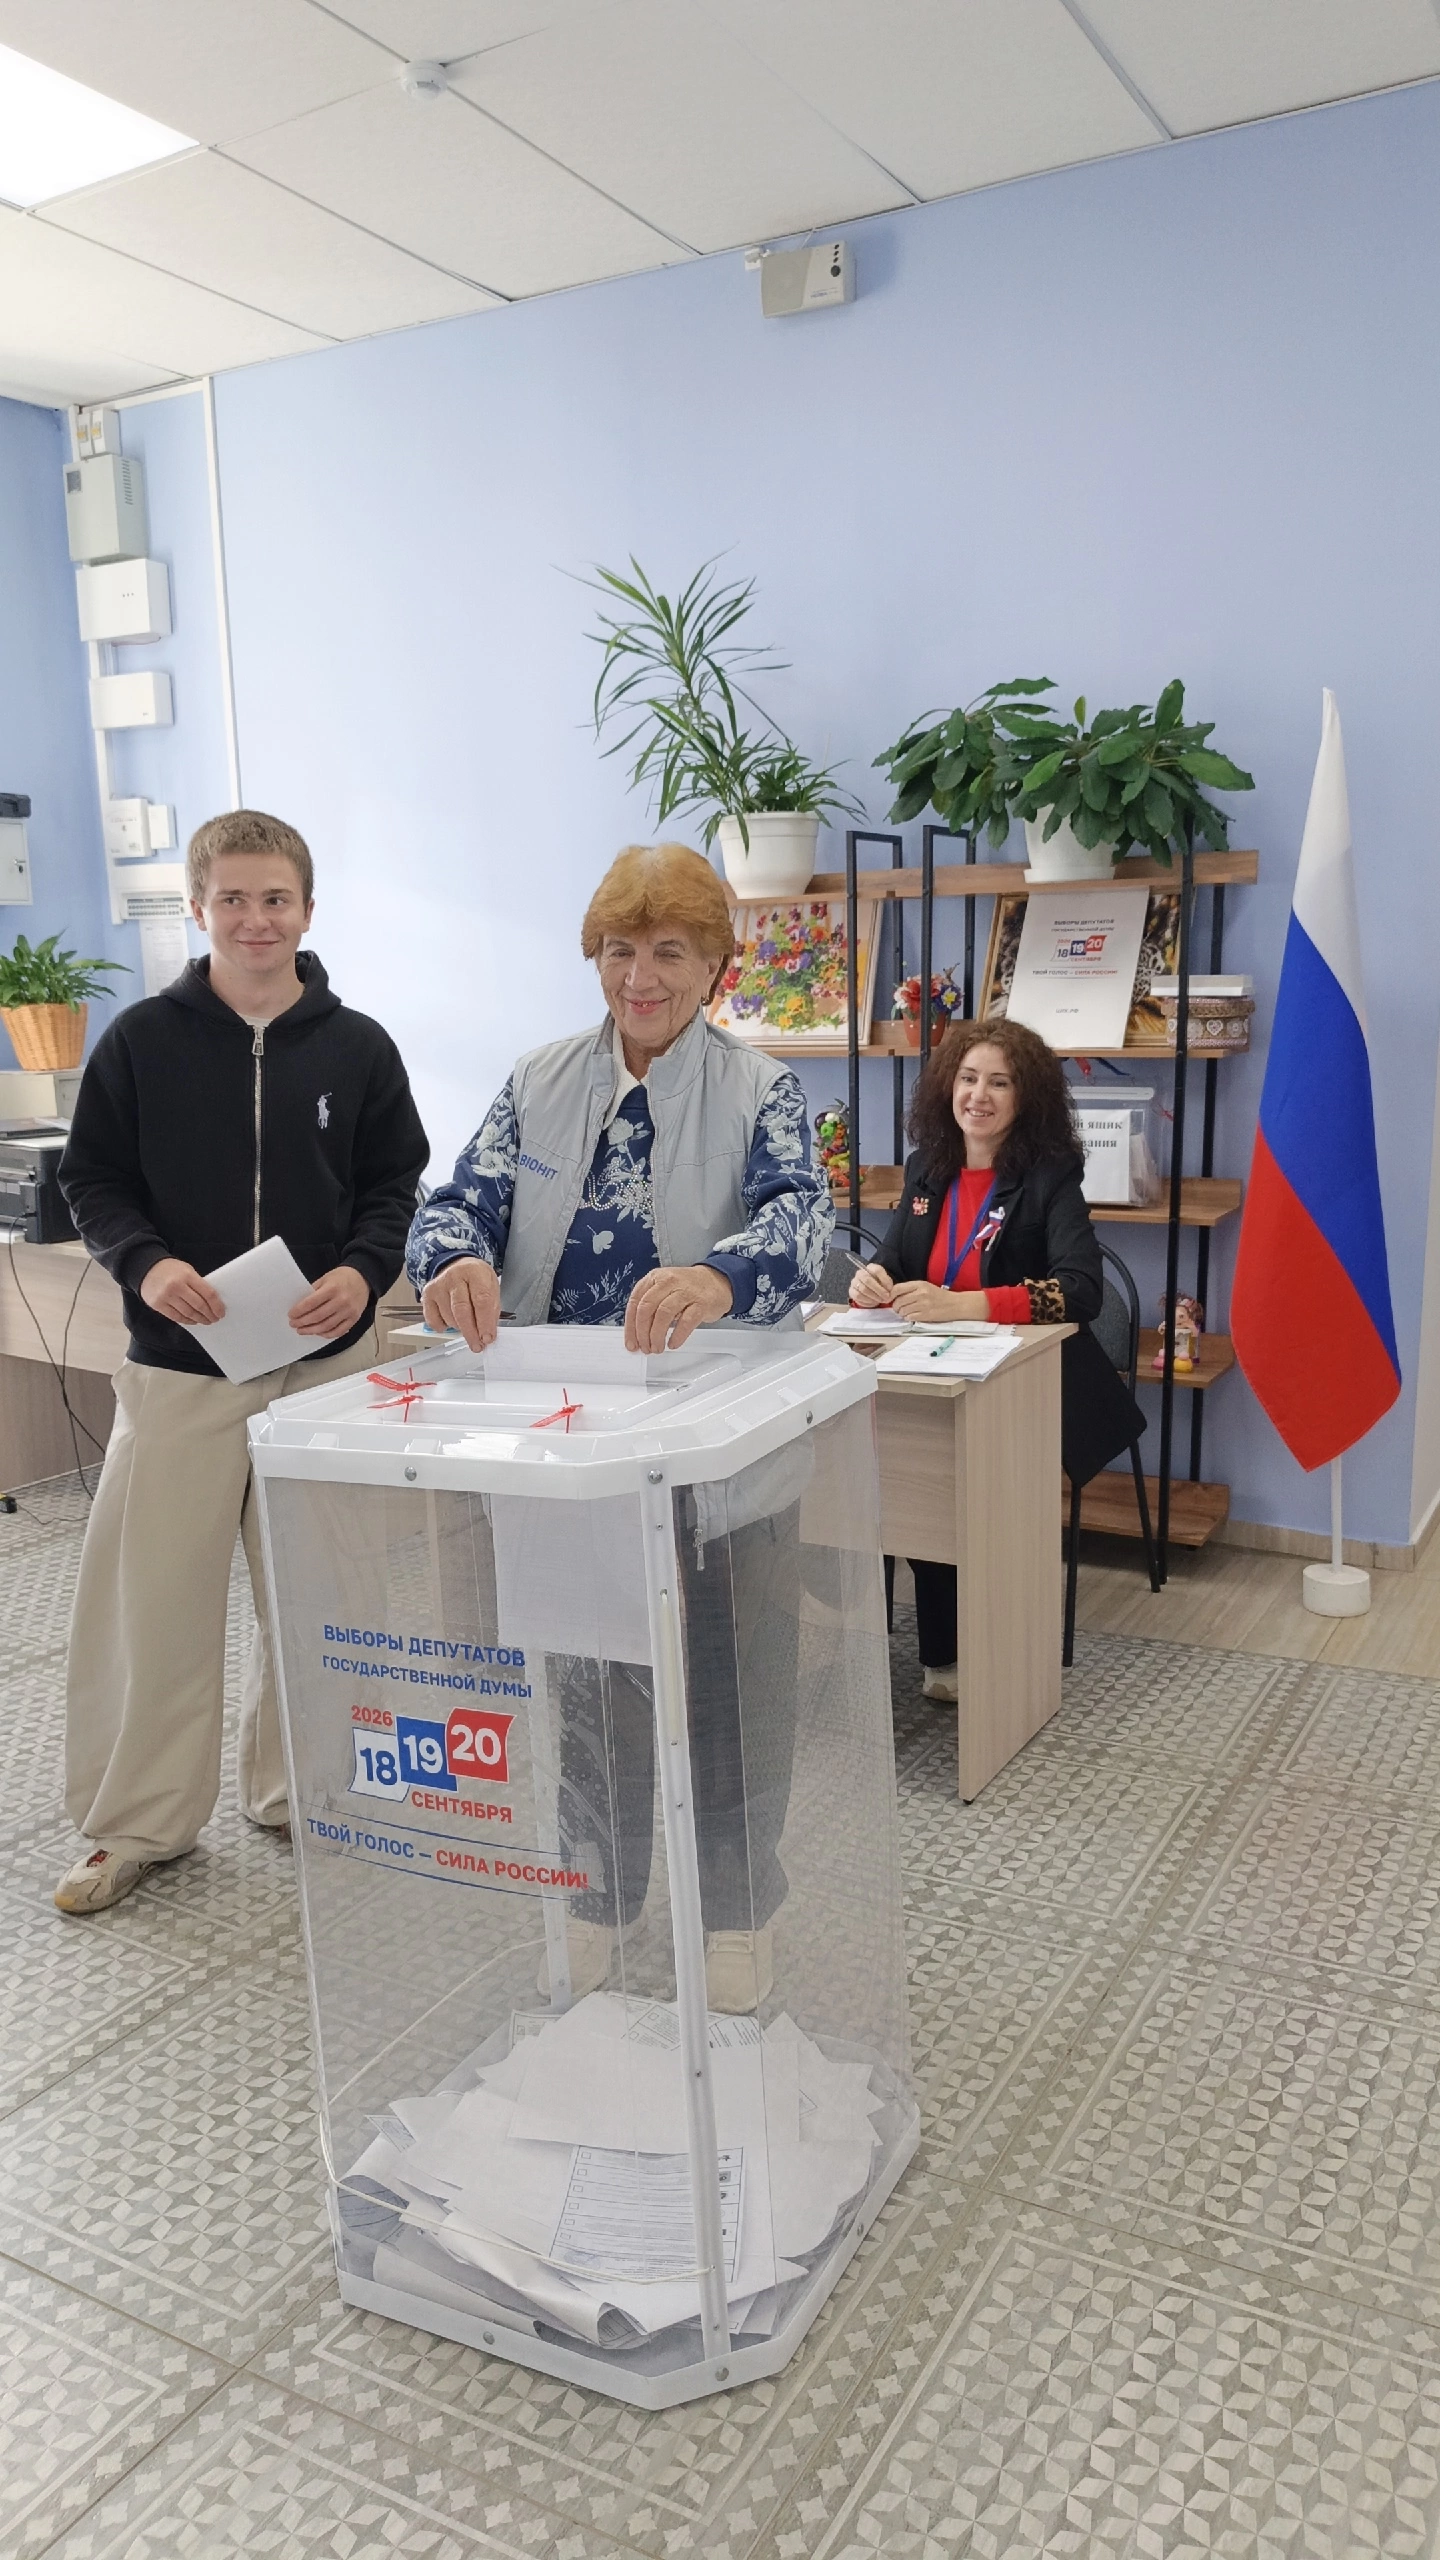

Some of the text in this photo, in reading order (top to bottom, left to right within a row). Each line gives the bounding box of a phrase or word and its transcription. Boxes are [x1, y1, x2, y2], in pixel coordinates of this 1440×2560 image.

[1057, 938, 1102, 958] 18 19 20
[519, 1154, 558, 1180] BIOHIT
[324, 1624, 526, 1668] ВЫБОРЫ ДЕПУТАТОВ
[322, 1655, 533, 1698] ГОСУДАРСТВЕННОЙ ДУМЫ
[351, 1704, 394, 1727] 2026
[359, 1724, 502, 1786] 18 19 20
[411, 1791, 513, 1824] СЕНТЯБРЯ
[306, 1818, 351, 1844] ТВОЙ
[355, 1831, 415, 1858] ГОЛОС
[435, 1849, 490, 1875] СИЛА
[494, 1861, 589, 1889] РОССИИ!
